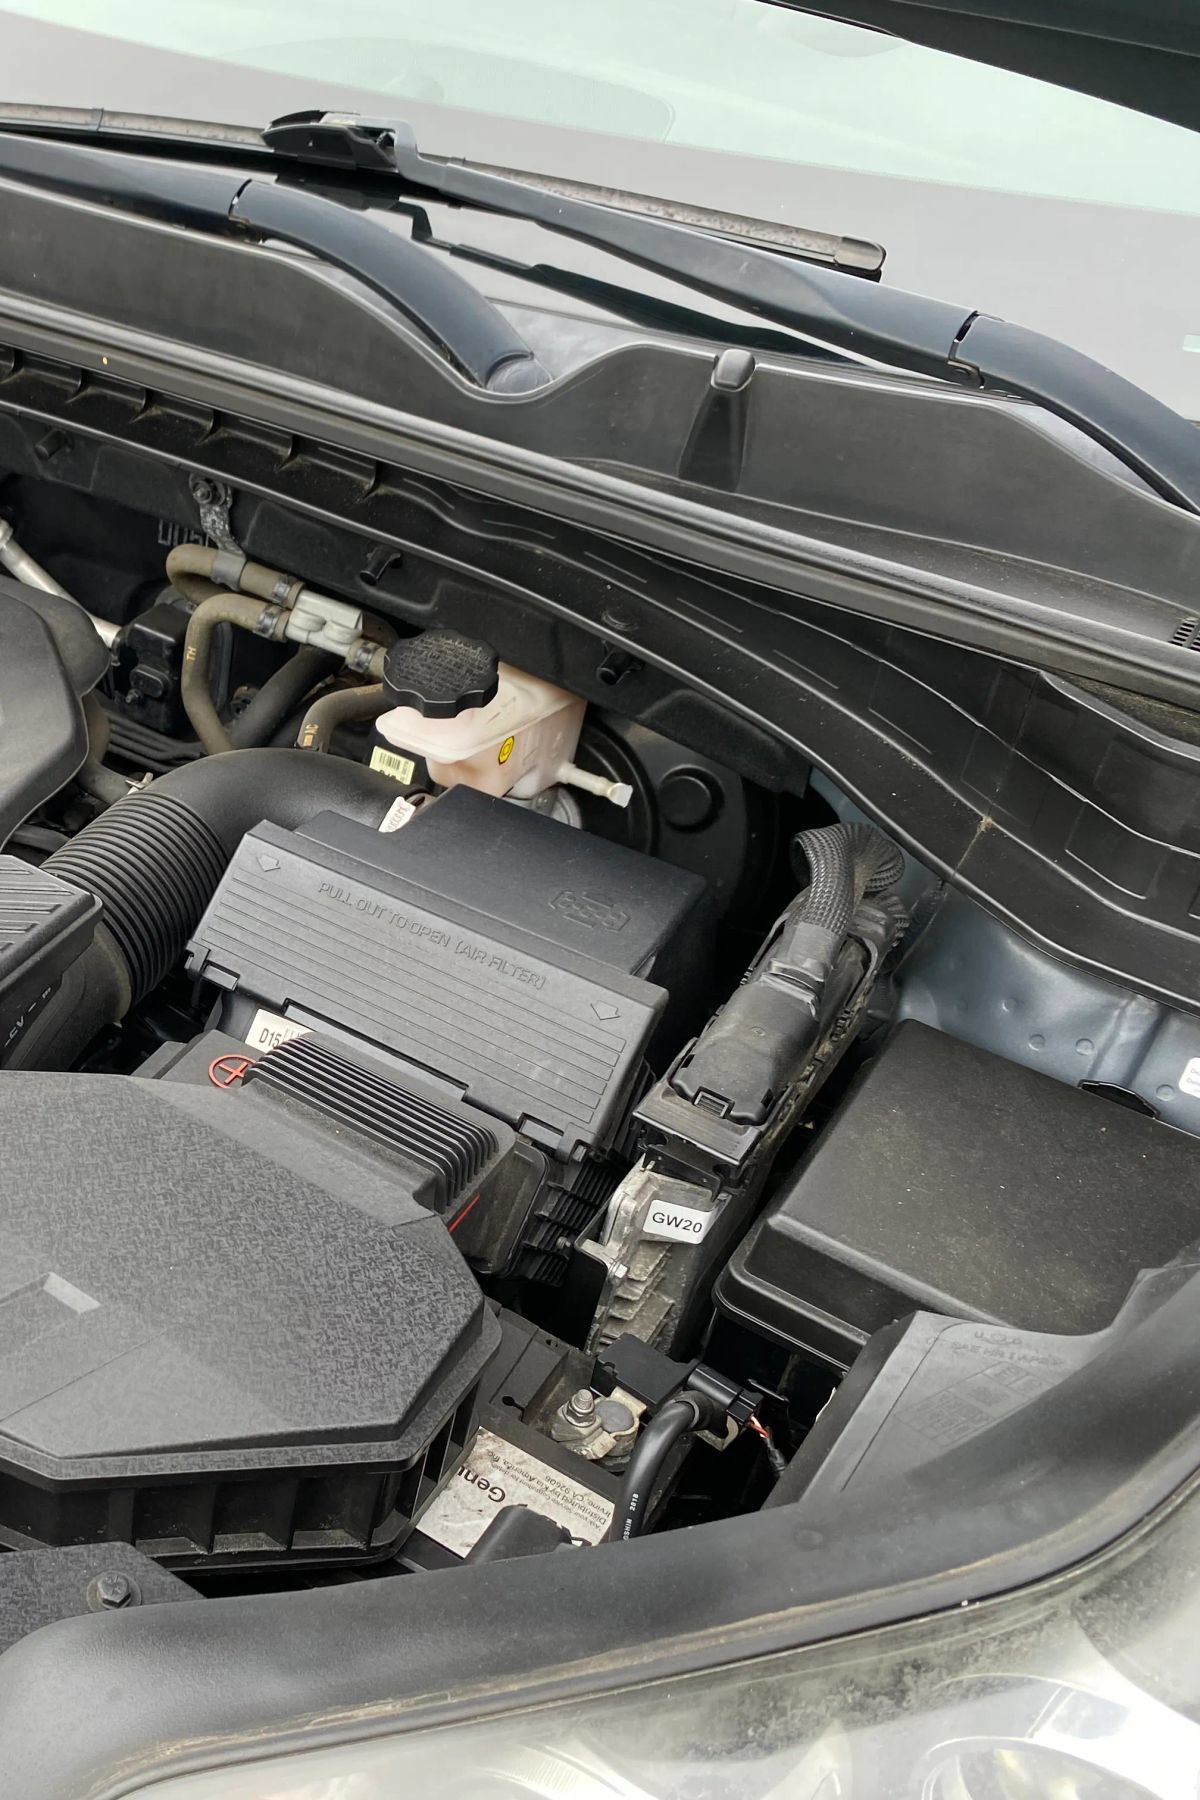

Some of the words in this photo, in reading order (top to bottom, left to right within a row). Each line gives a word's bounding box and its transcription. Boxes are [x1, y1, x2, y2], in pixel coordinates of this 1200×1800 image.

[318, 882, 352, 906] PULL
[357, 898, 387, 920] OUT
[389, 911, 409, 929] TO
[409, 921, 452, 948] OPEN
[652, 1211, 703, 1234] GW20
[535, 1479, 550, 1491] Kia
[548, 1485, 562, 1498] by
[570, 1489, 584, 1502] CA
[560, 1494, 607, 1525] Distributed
